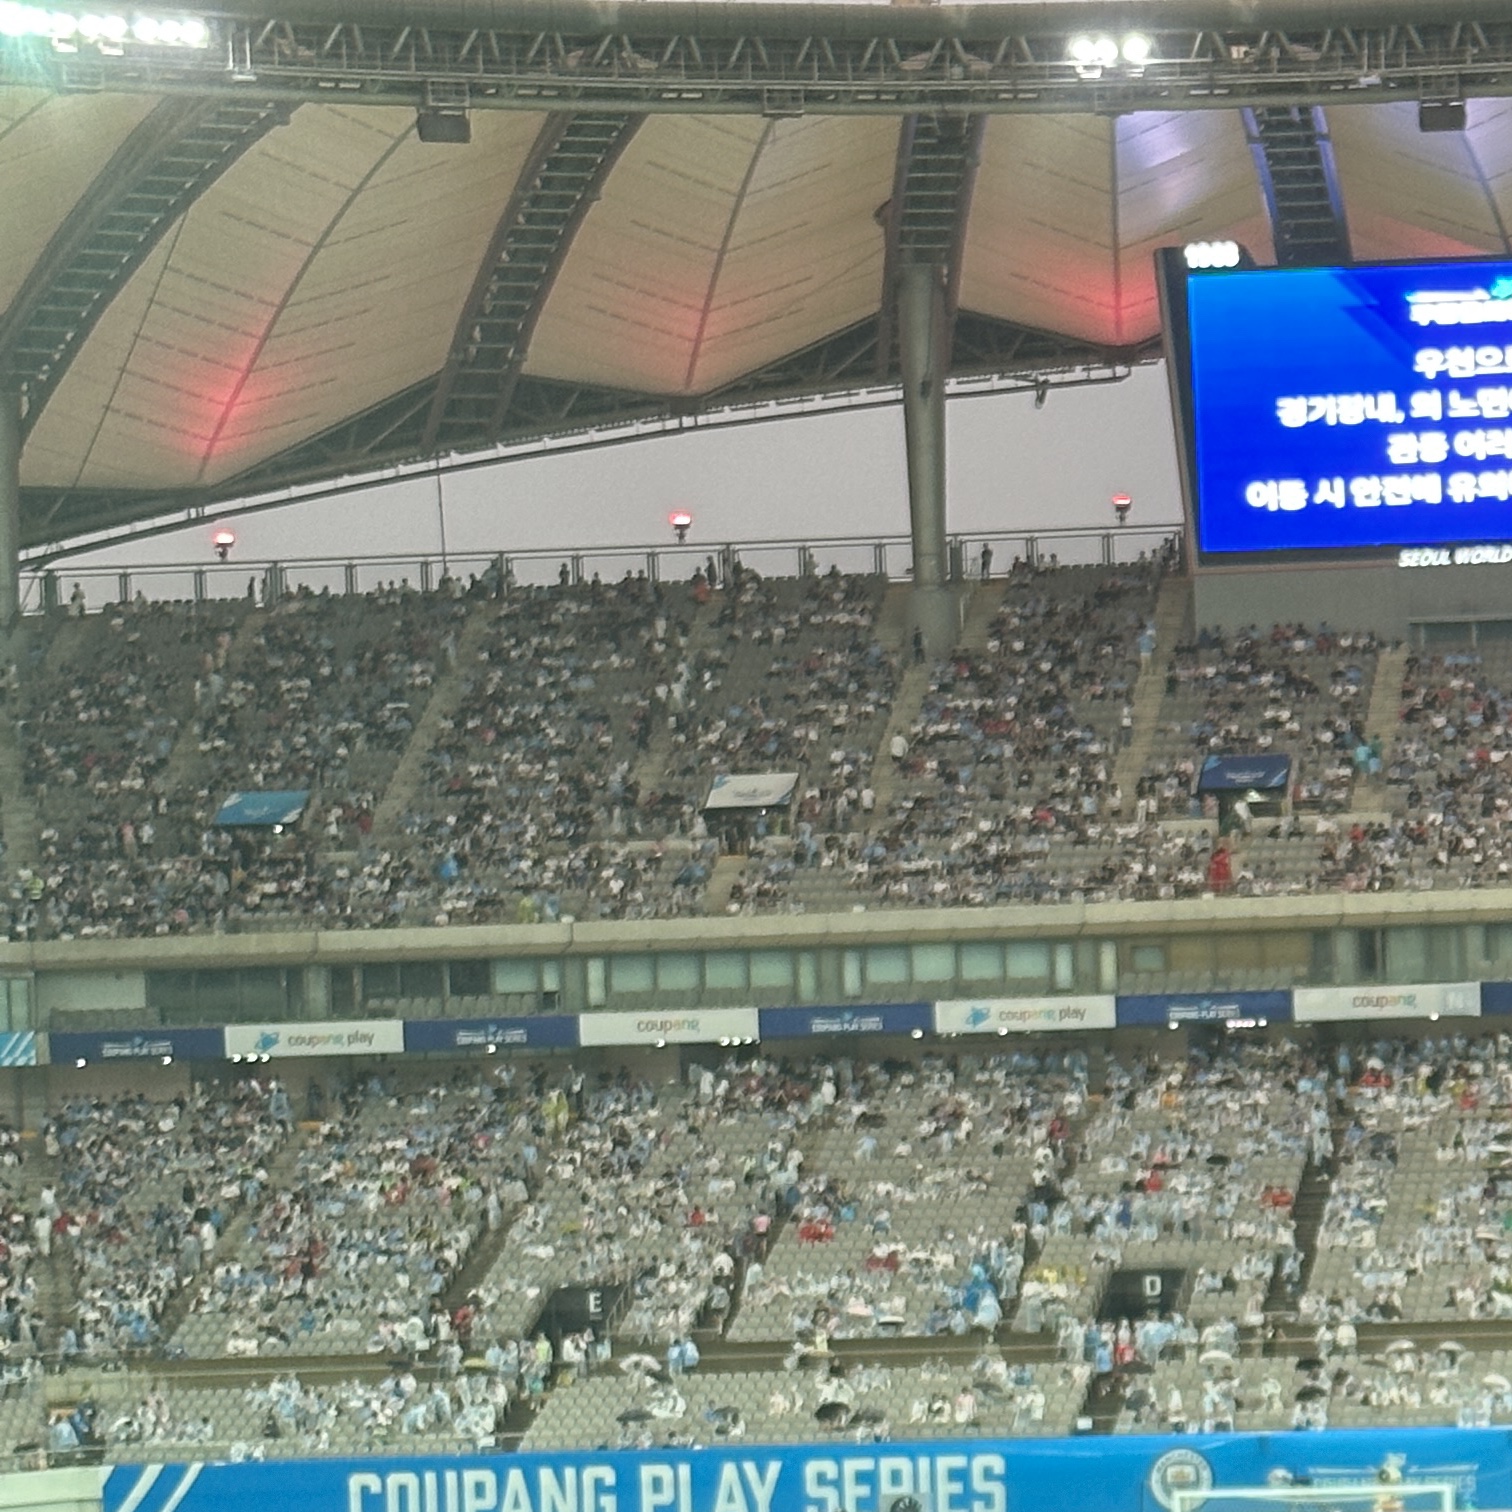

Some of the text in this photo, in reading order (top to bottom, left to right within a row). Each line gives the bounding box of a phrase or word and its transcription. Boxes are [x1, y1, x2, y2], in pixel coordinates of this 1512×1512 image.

[1399, 548, 1451, 567] SEOUL
[346, 1029, 375, 1048] play
[1145, 1274, 1163, 1297] D
[589, 1291, 603, 1314] E
